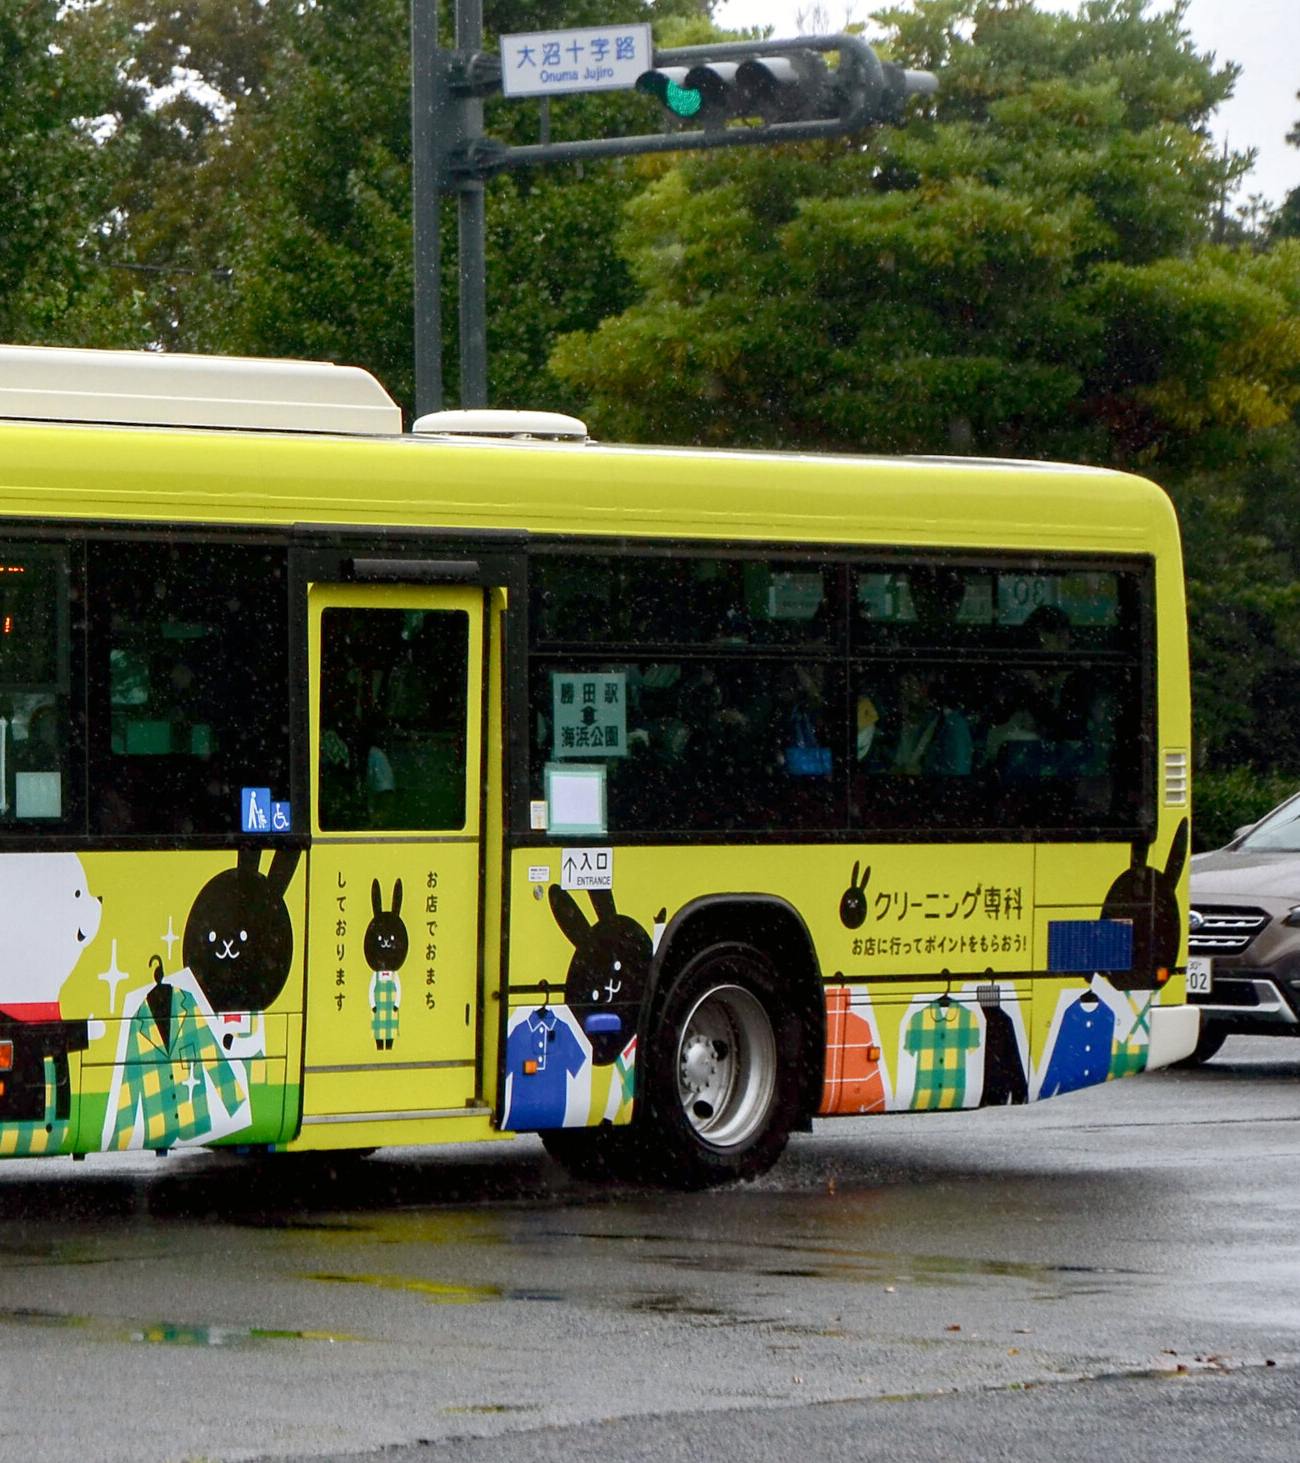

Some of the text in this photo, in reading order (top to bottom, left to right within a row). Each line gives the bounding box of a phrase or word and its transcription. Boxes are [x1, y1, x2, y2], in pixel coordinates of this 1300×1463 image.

[516, 36, 635, 68] 大沼十字路
[540, 67, 614, 83] Onuma Jujiro
[560, 682, 619, 704] 勝田駅
[561, 725, 619, 748] 海浜公園
[580, 852, 608, 871] 入口
[576, 875, 612, 886] ENTRANCE
[874, 883, 1023, 921] クリーニング専科
[334, 871, 347, 1011] しております
[425, 871, 438, 1010] お店でおまち
